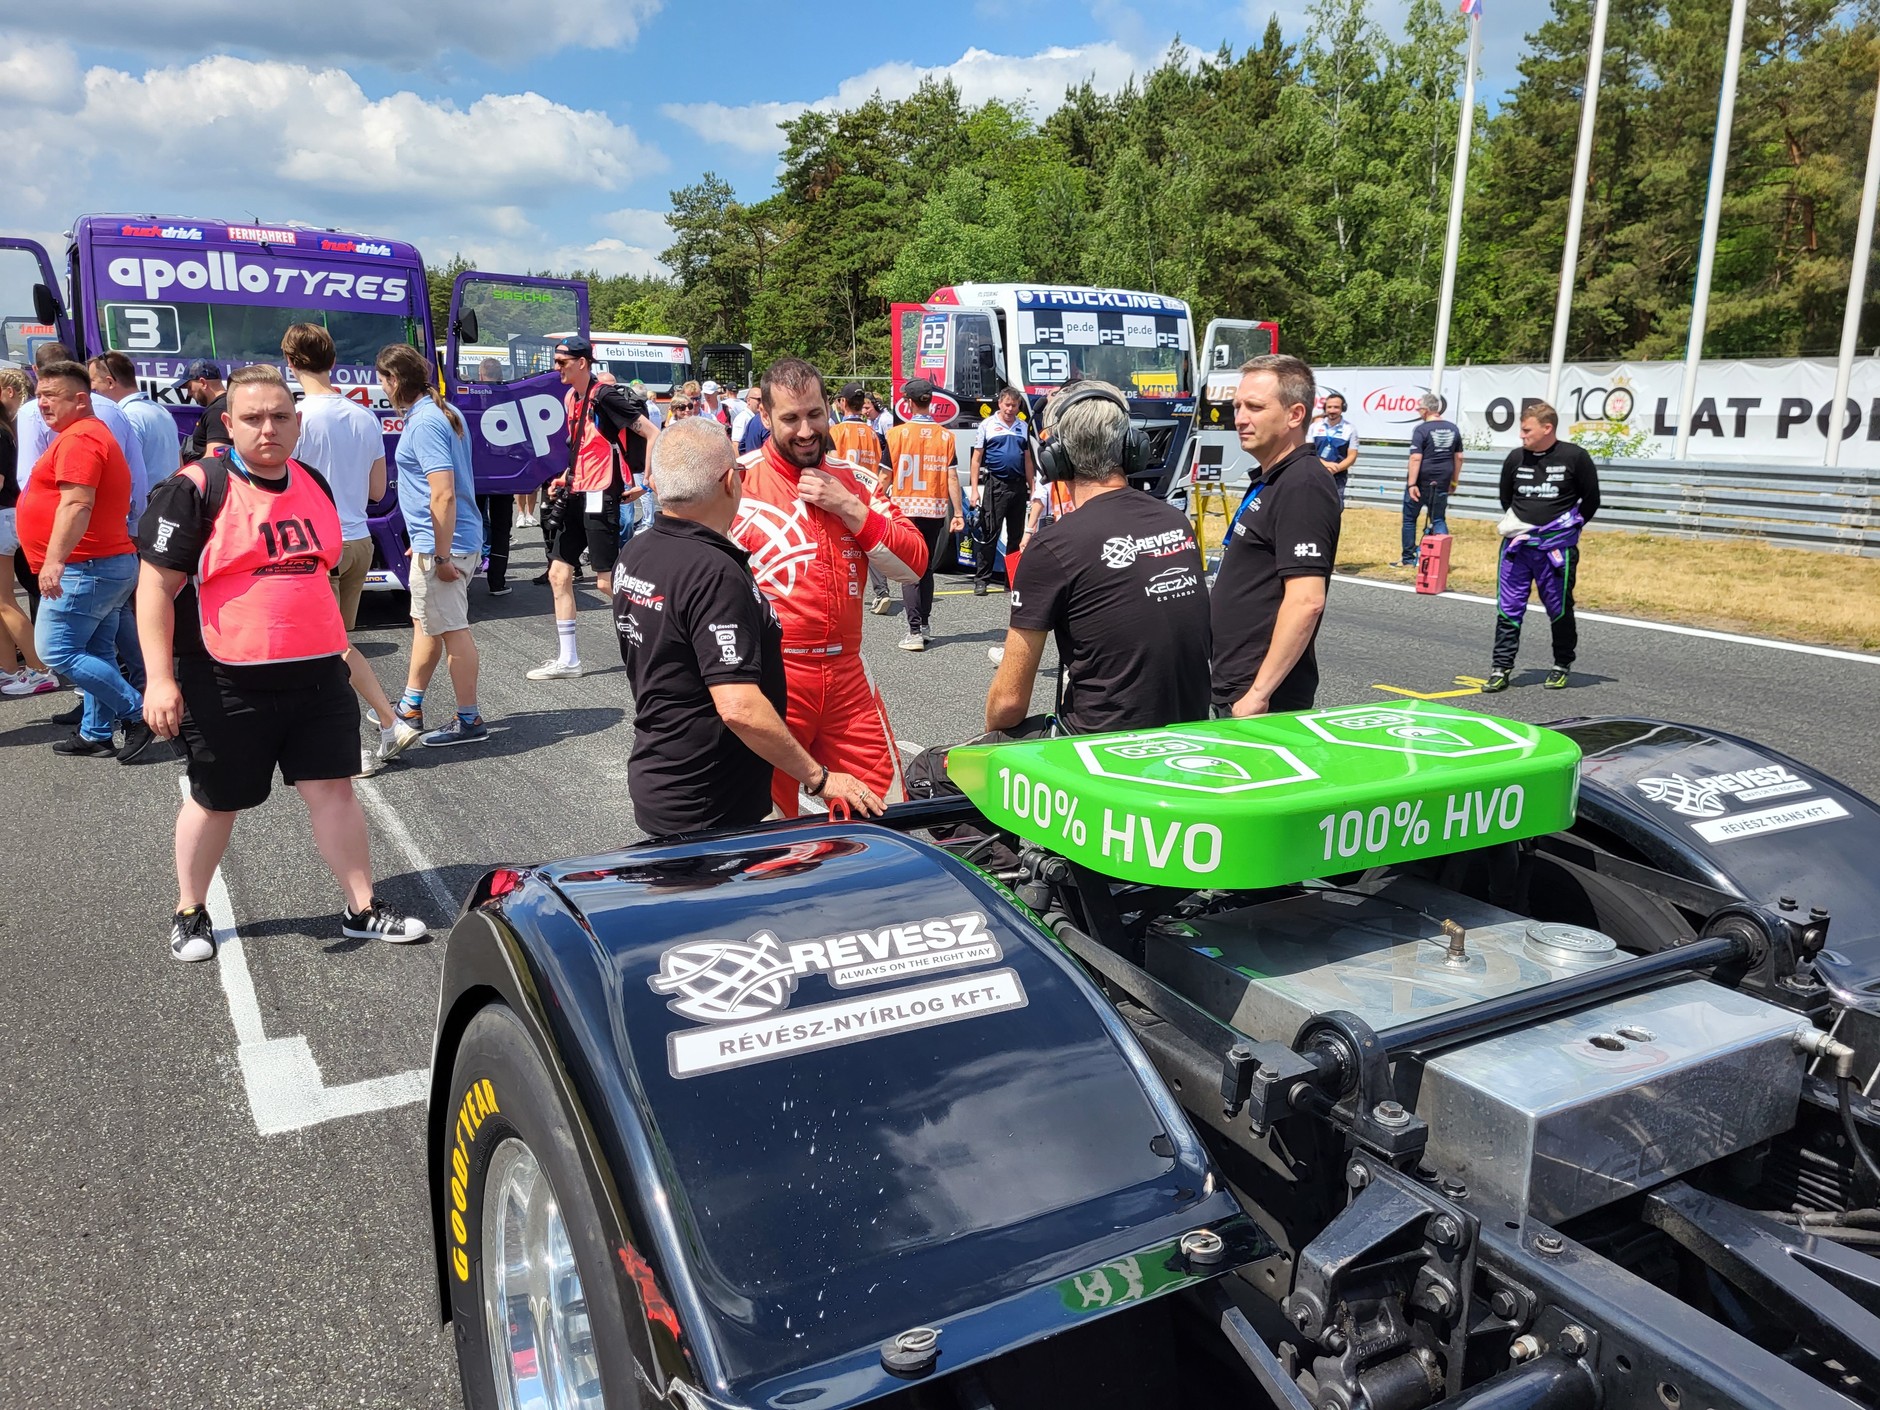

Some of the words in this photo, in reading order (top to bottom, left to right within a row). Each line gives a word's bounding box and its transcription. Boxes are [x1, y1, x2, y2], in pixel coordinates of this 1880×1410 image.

[229, 227, 296, 244] FERNFAHRER
[108, 251, 270, 299] apollo
[273, 268, 407, 302] TYRES
[492, 290, 553, 303] SASCHA
[1032, 290, 1162, 309] TRUCKLINE
[125, 309, 161, 348] 3
[923, 324, 946, 349] 23
[1066, 322, 1095, 333] pe.de
[1127, 325, 1153, 336] pe.de
[606, 347, 625, 357] febi
[627, 349, 664, 358] bilstein
[1030, 352, 1068, 380] 23
[137, 362, 188, 378] TEA
[1653, 397, 1762, 438] LAT
[898, 453, 927, 491] PL
[258, 518, 323, 559] 101
[1294, 543, 1322, 557] #1
[998, 767, 1087, 847] 100%
[1101, 807, 1223, 874] HVO
[1318, 800, 1430, 861] 100%
[1442, 784, 1525, 840] HVO
[1720, 817, 1769, 835] RÉVÉSZ
[1766, 810, 1806, 825] TRANS
[1803, 806, 1831, 817] KFT.
[839, 965, 886, 981] ALWAYS
[888, 961, 906, 972] ON
[909, 957, 930, 968] THE
[932, 950, 965, 965] RIGHT
[966, 947, 992, 958] WAY
[718, 997, 946, 1057] RÉVÉSZ-NYÍRLOG
[950, 986, 1001, 1008] KFT.
